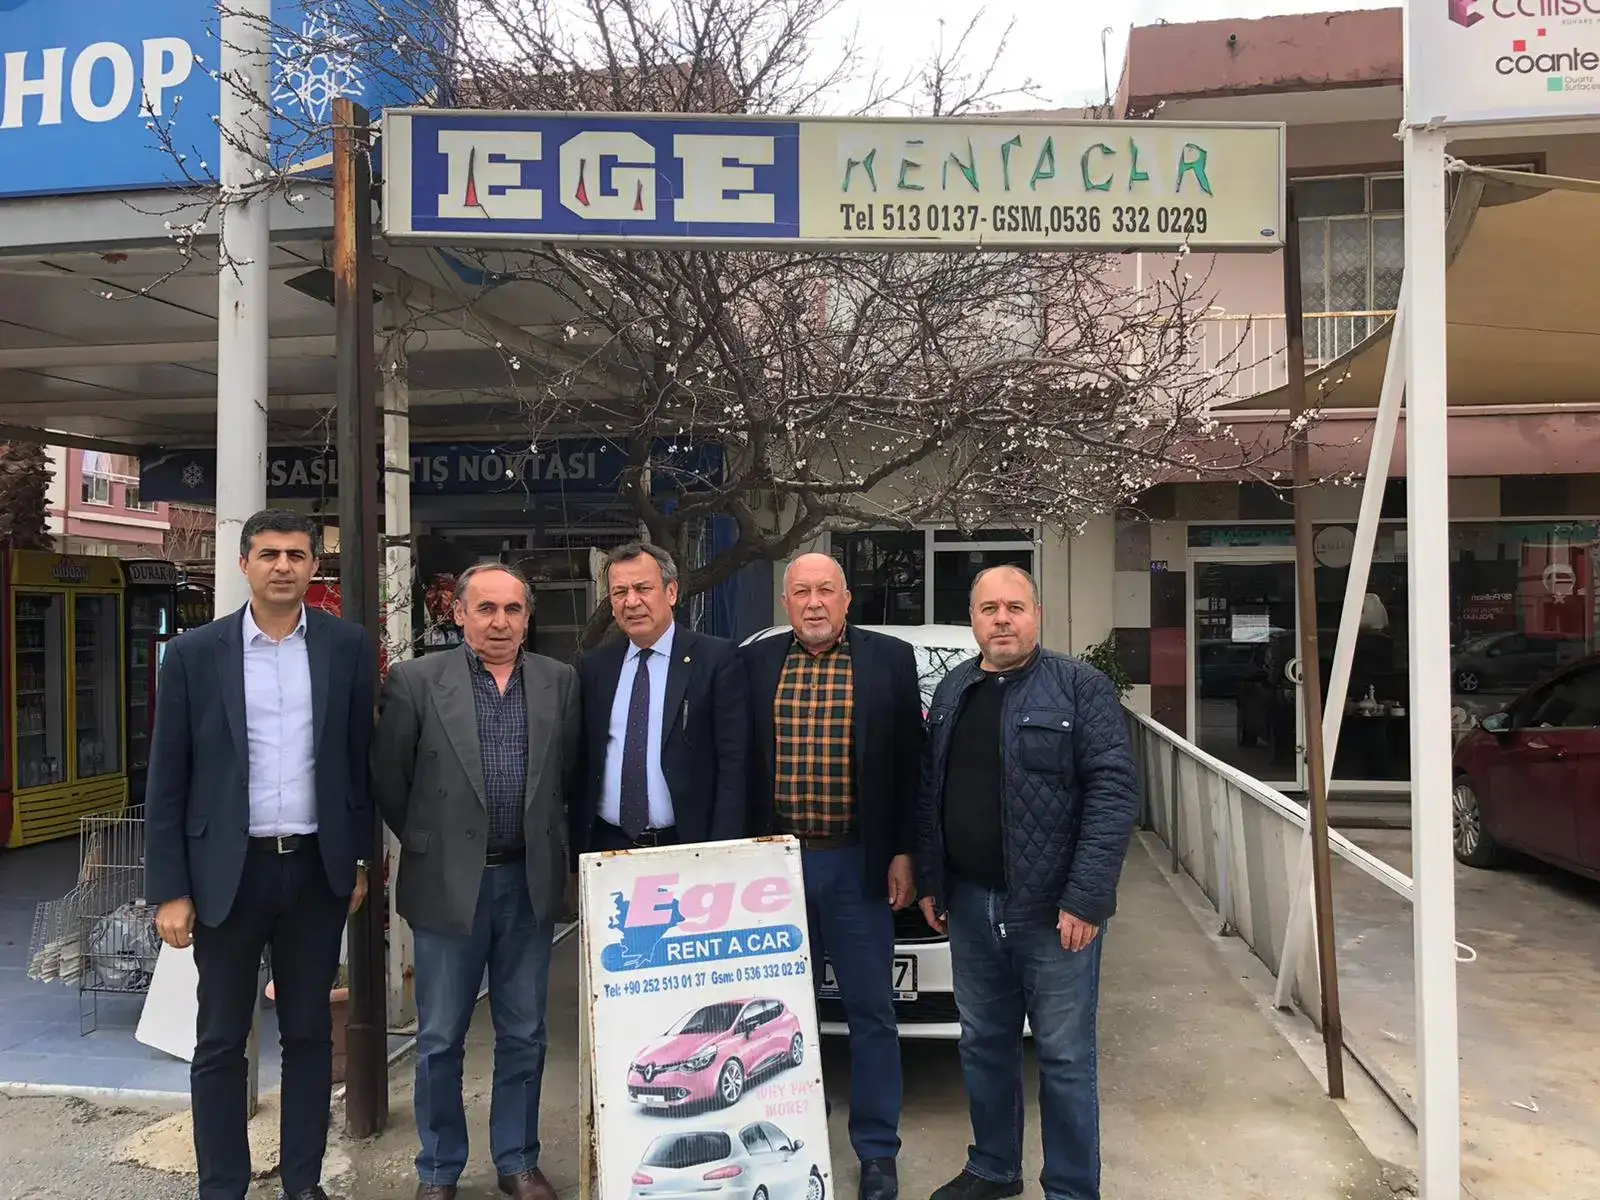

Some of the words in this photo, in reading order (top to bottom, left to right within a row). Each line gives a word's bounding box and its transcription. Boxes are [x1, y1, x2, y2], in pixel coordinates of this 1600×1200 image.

[1496, 47, 1600, 75] coante
[0, 37, 193, 129] HOP
[438, 130, 775, 223] EGE
[840, 204, 875, 231] Tel
[883, 204, 921, 231] 513
[1112, 206, 1150, 233] 332
[1157, 207, 1207, 234] 0229
[624, 873, 793, 933] Ege
[667, 938, 722, 961] RENT
[728, 936, 743, 954] A
[747, 931, 791, 952] CAR
[603, 983, 621, 998] Tel:
[623, 980, 641, 995] +90
[643, 978, 660, 993] 252
[662, 975, 679, 991] 513
[681, 974, 692, 989] 01
[695, 972, 706, 987] 37
[711, 970, 735, 985] Gsm:
[736, 968, 743, 981] 0
[744, 966, 761, 980] 536
[763, 964, 780, 978] 332
[781, 962, 793, 976] 02
[794, 961, 806, 975] 29
[756, 1084, 786, 1101] WHY
[790, 1080, 815, 1096] PAY
[764, 1099, 809, 1118] MORE?
